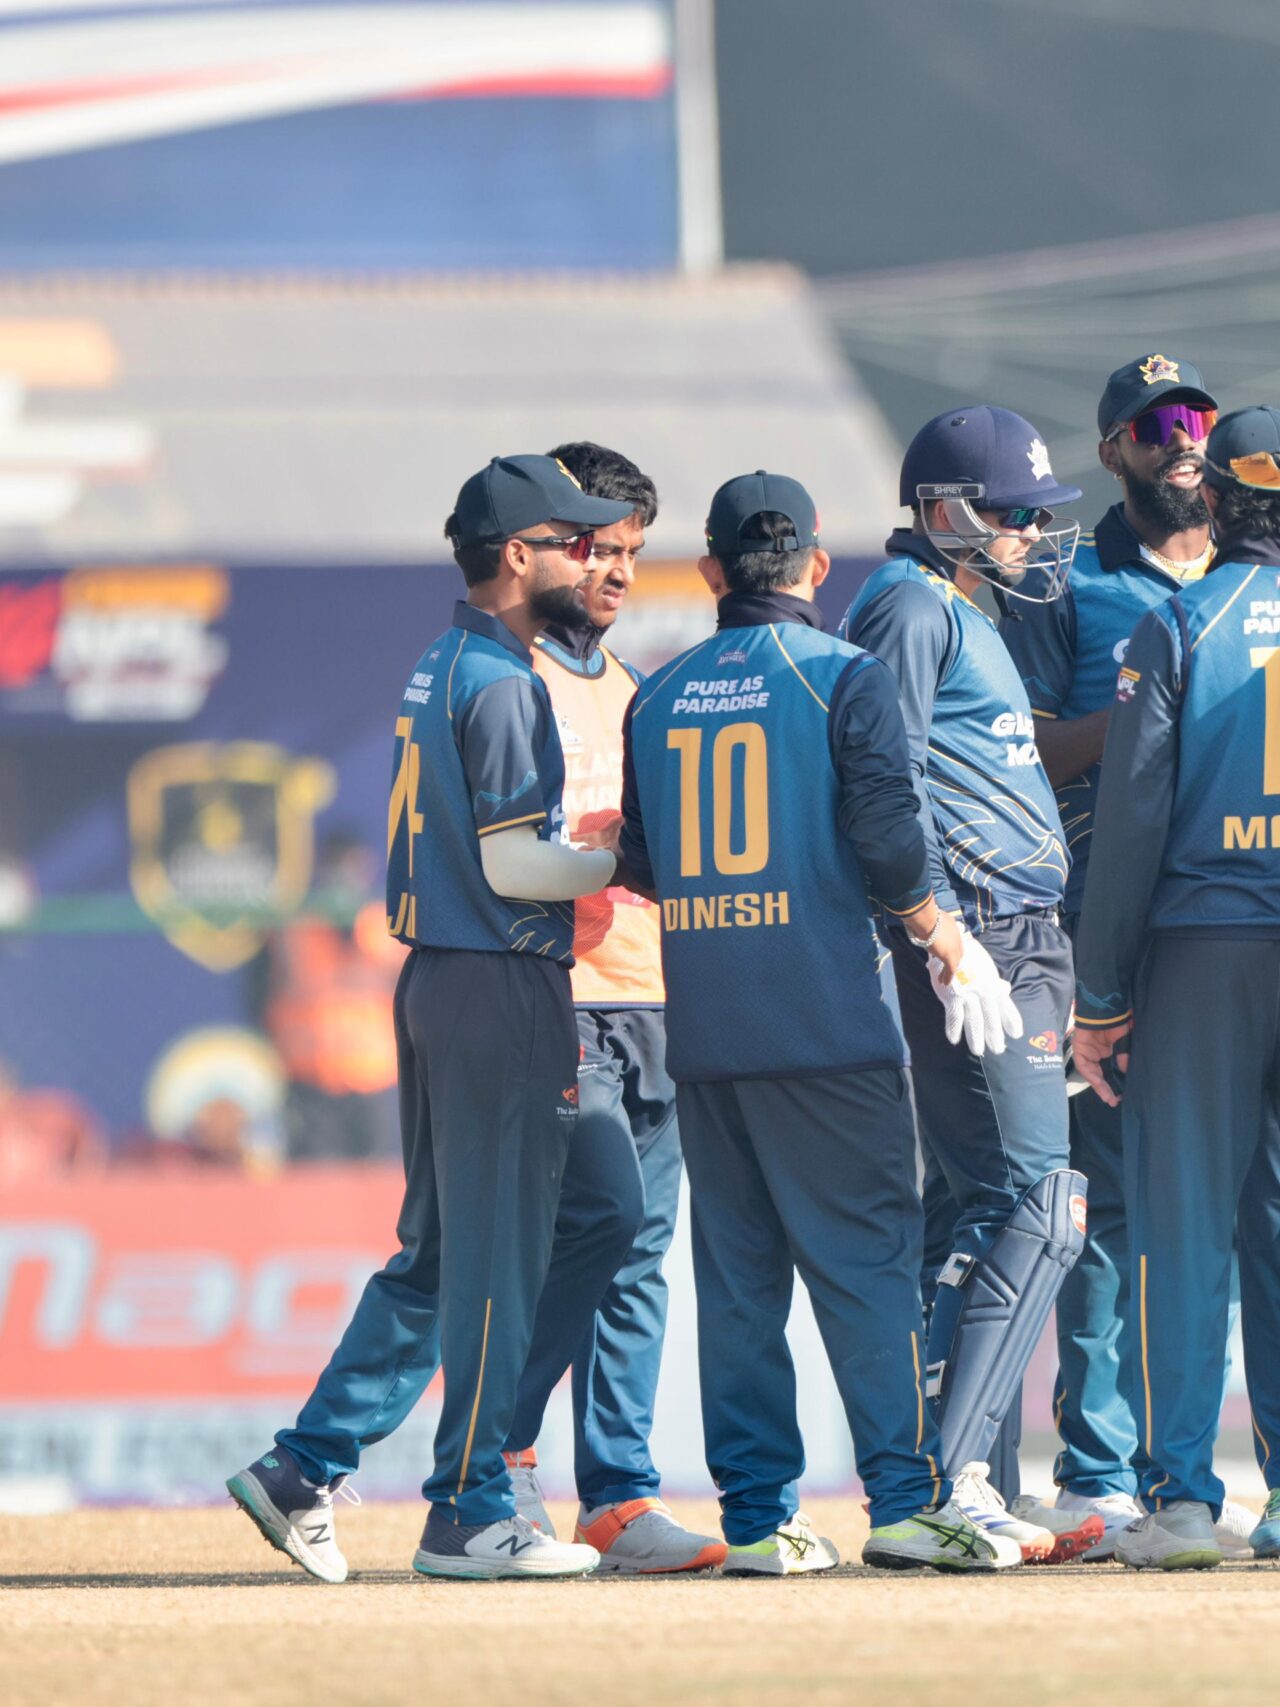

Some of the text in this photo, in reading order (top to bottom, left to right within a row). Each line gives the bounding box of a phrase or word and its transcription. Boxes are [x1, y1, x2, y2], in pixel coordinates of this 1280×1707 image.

[934, 486, 963, 494] SHREY
[682, 675, 765, 697] PURE AS
[671, 691, 771, 714] PARADISE
[667, 721, 769, 878] 10
[662, 891, 790, 932] DINESH
